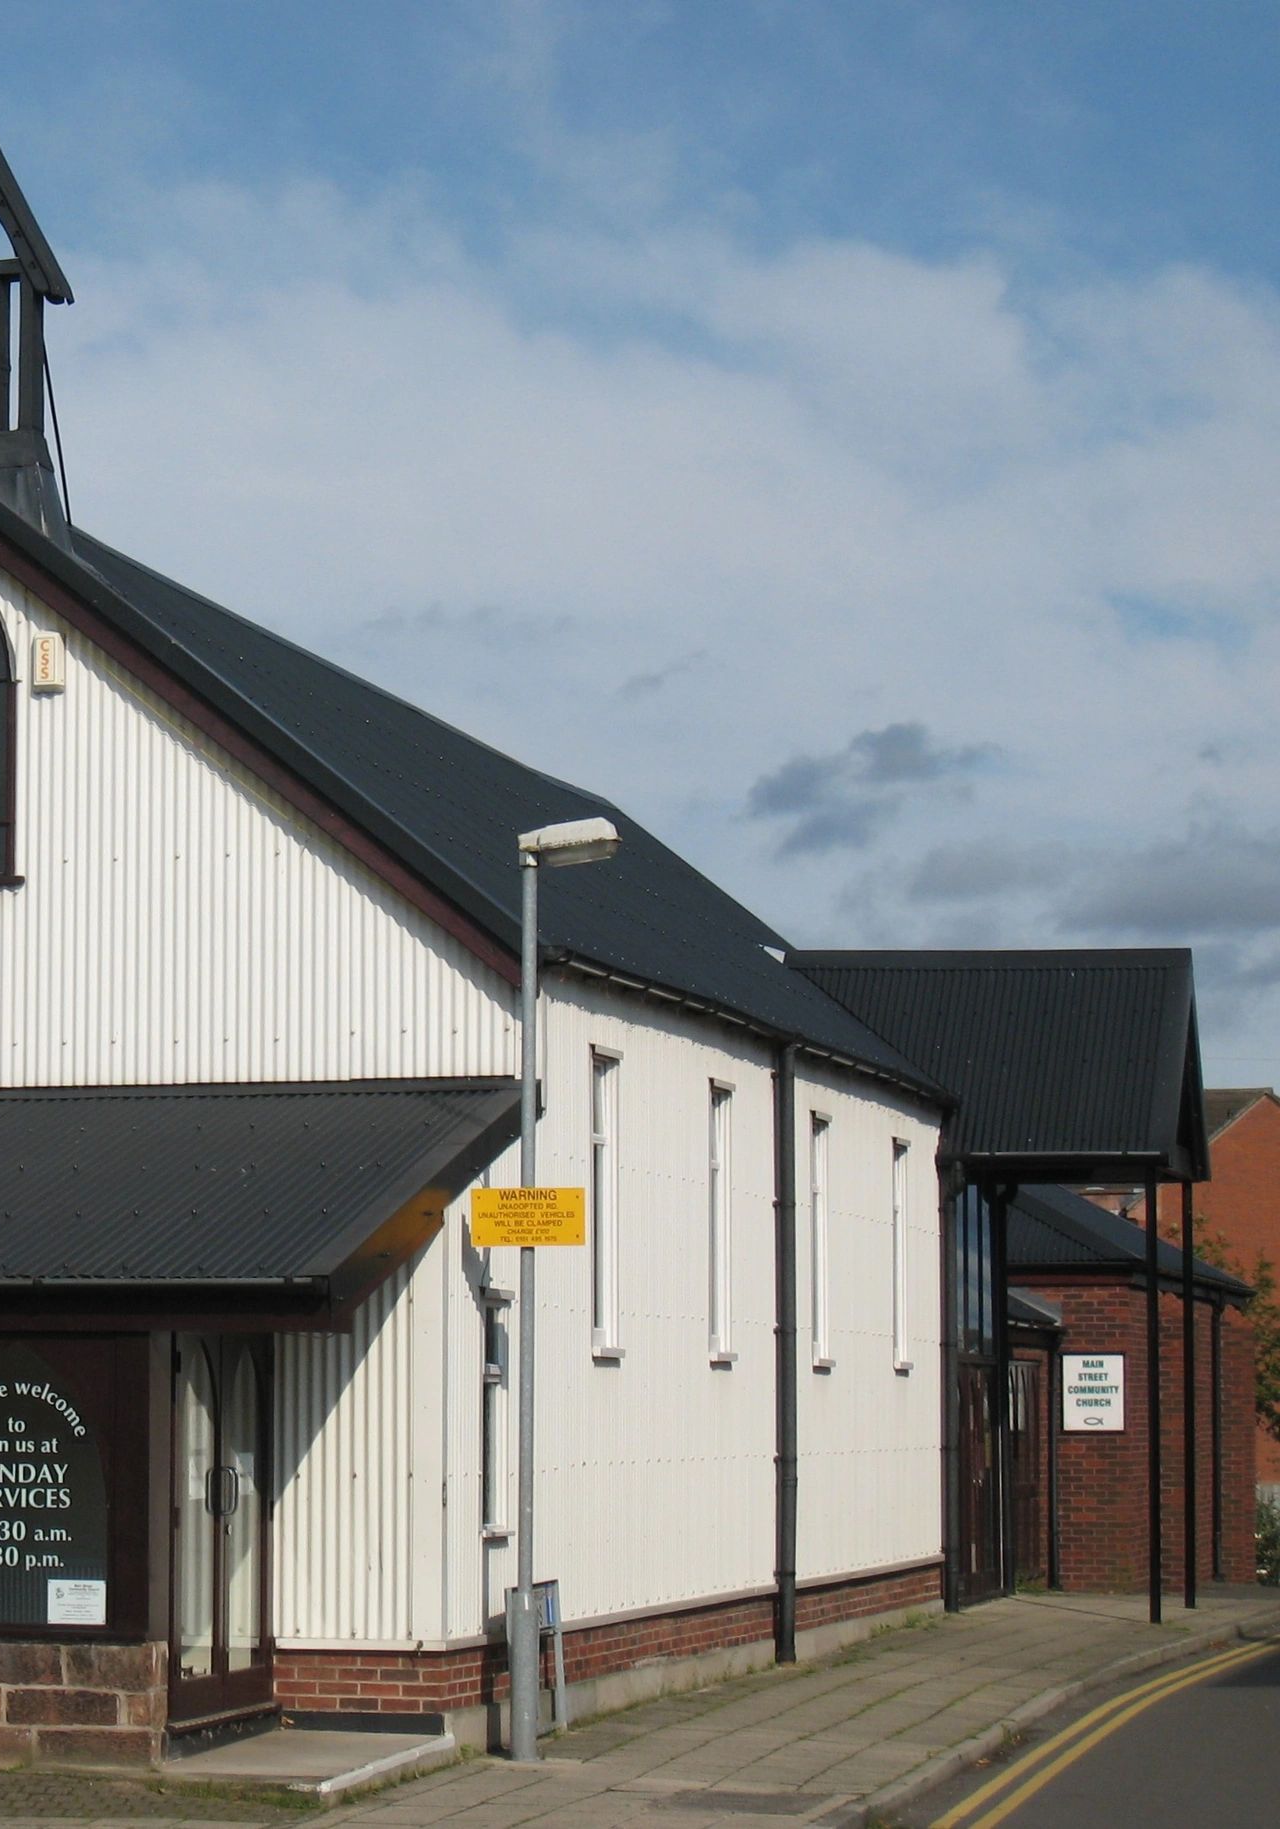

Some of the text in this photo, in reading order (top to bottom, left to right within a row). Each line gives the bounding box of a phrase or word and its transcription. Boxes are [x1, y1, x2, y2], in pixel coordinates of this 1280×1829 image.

[499, 1189, 557, 1201] WARNING
[497, 1202, 544, 1210] UNADOPTED
[478, 1210, 575, 1219] UNAUTHORISED VEHICLES
[494, 1219, 563, 1227] WILL BE CLAMPED
[1082, 1360, 1104, 1368] MAIN
[1078, 1372, 1108, 1381] STREET
[1067, 1385, 1119, 1394] COMMUNITY
[1075, 1398, 1111, 1407] CHURCH
[14, 1382, 86, 1437] welcome
[7, 1416, 26, 1433] to
[15, 1440, 35, 1453] us
[40, 1438, 58, 1454] at
[33, 1528, 73, 1542] a.m.
[25, 1553, 65, 1571] p.m.
